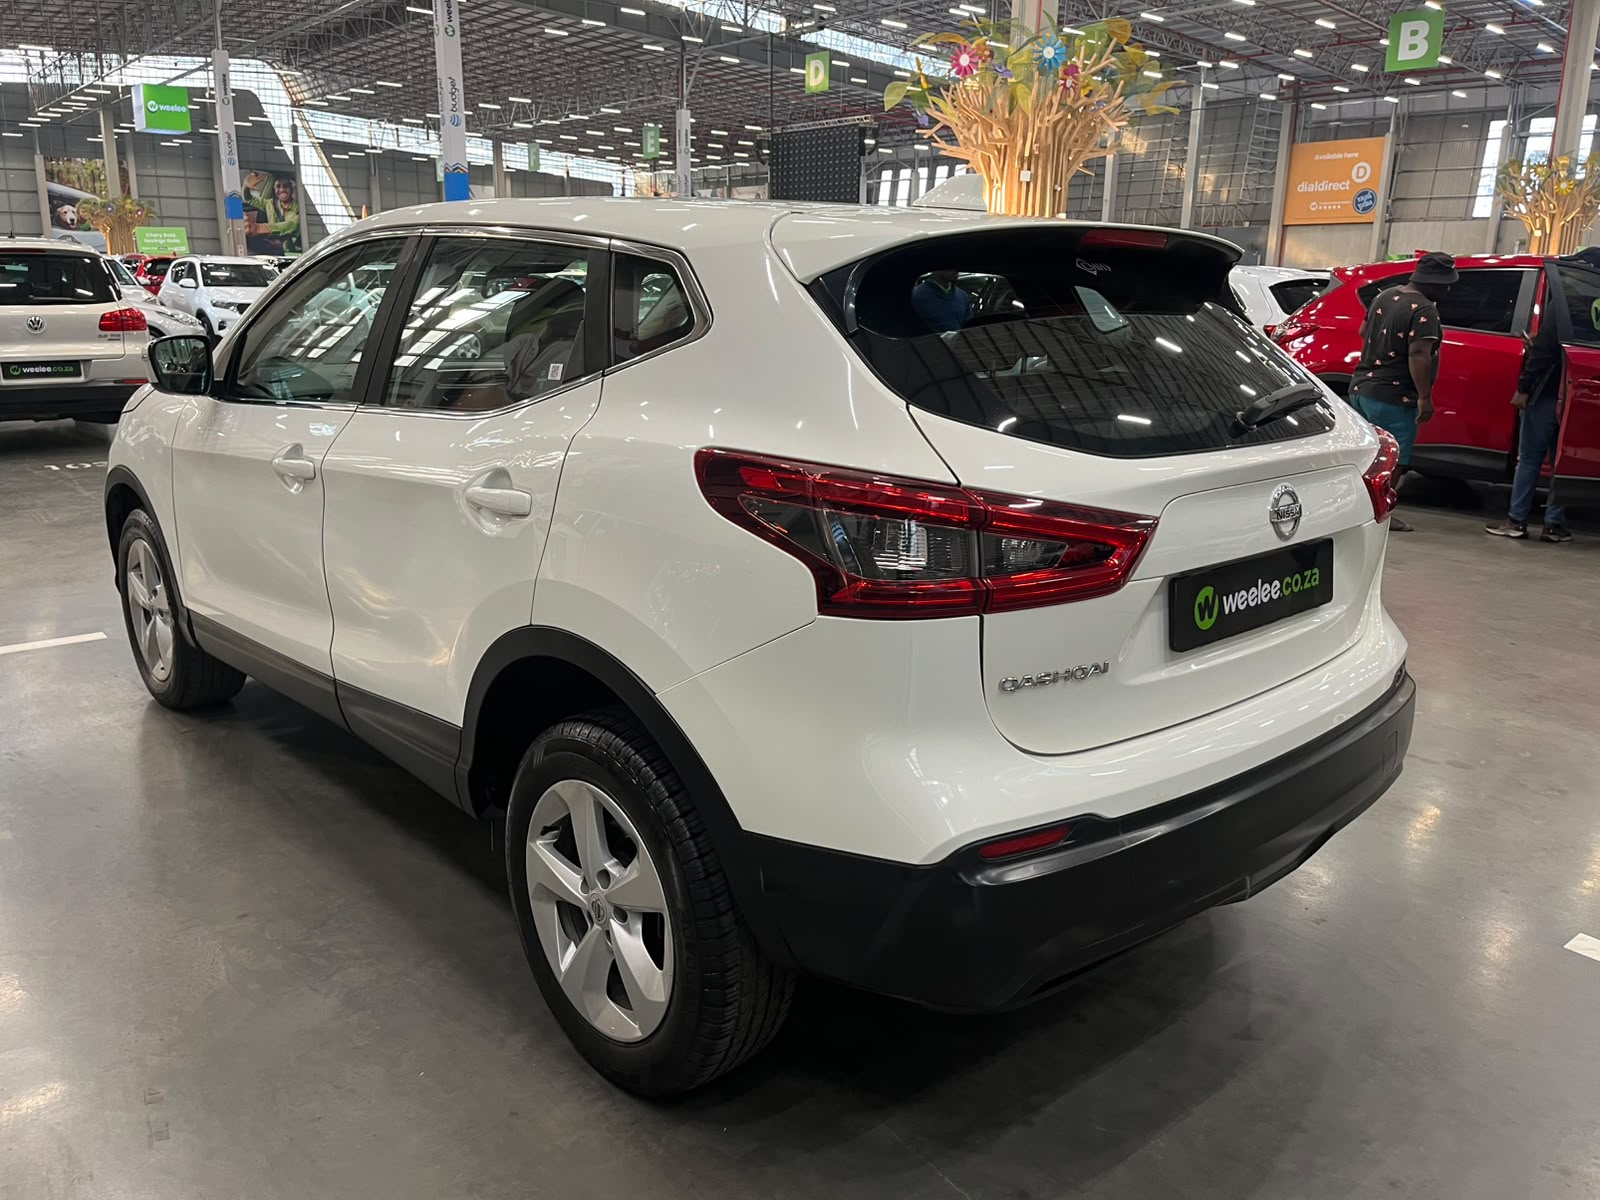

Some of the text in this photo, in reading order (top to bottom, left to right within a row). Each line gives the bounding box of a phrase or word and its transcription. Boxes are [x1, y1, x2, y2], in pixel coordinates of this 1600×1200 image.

[1398, 20, 1430, 61] B
[810, 59, 825, 87] D
[647, 130, 655, 153] E
[1297, 180, 1350, 193] dialdirect
[1223, 567, 1320, 615] weelee.co.za
[998, 660, 1110, 693] QASHQAI
